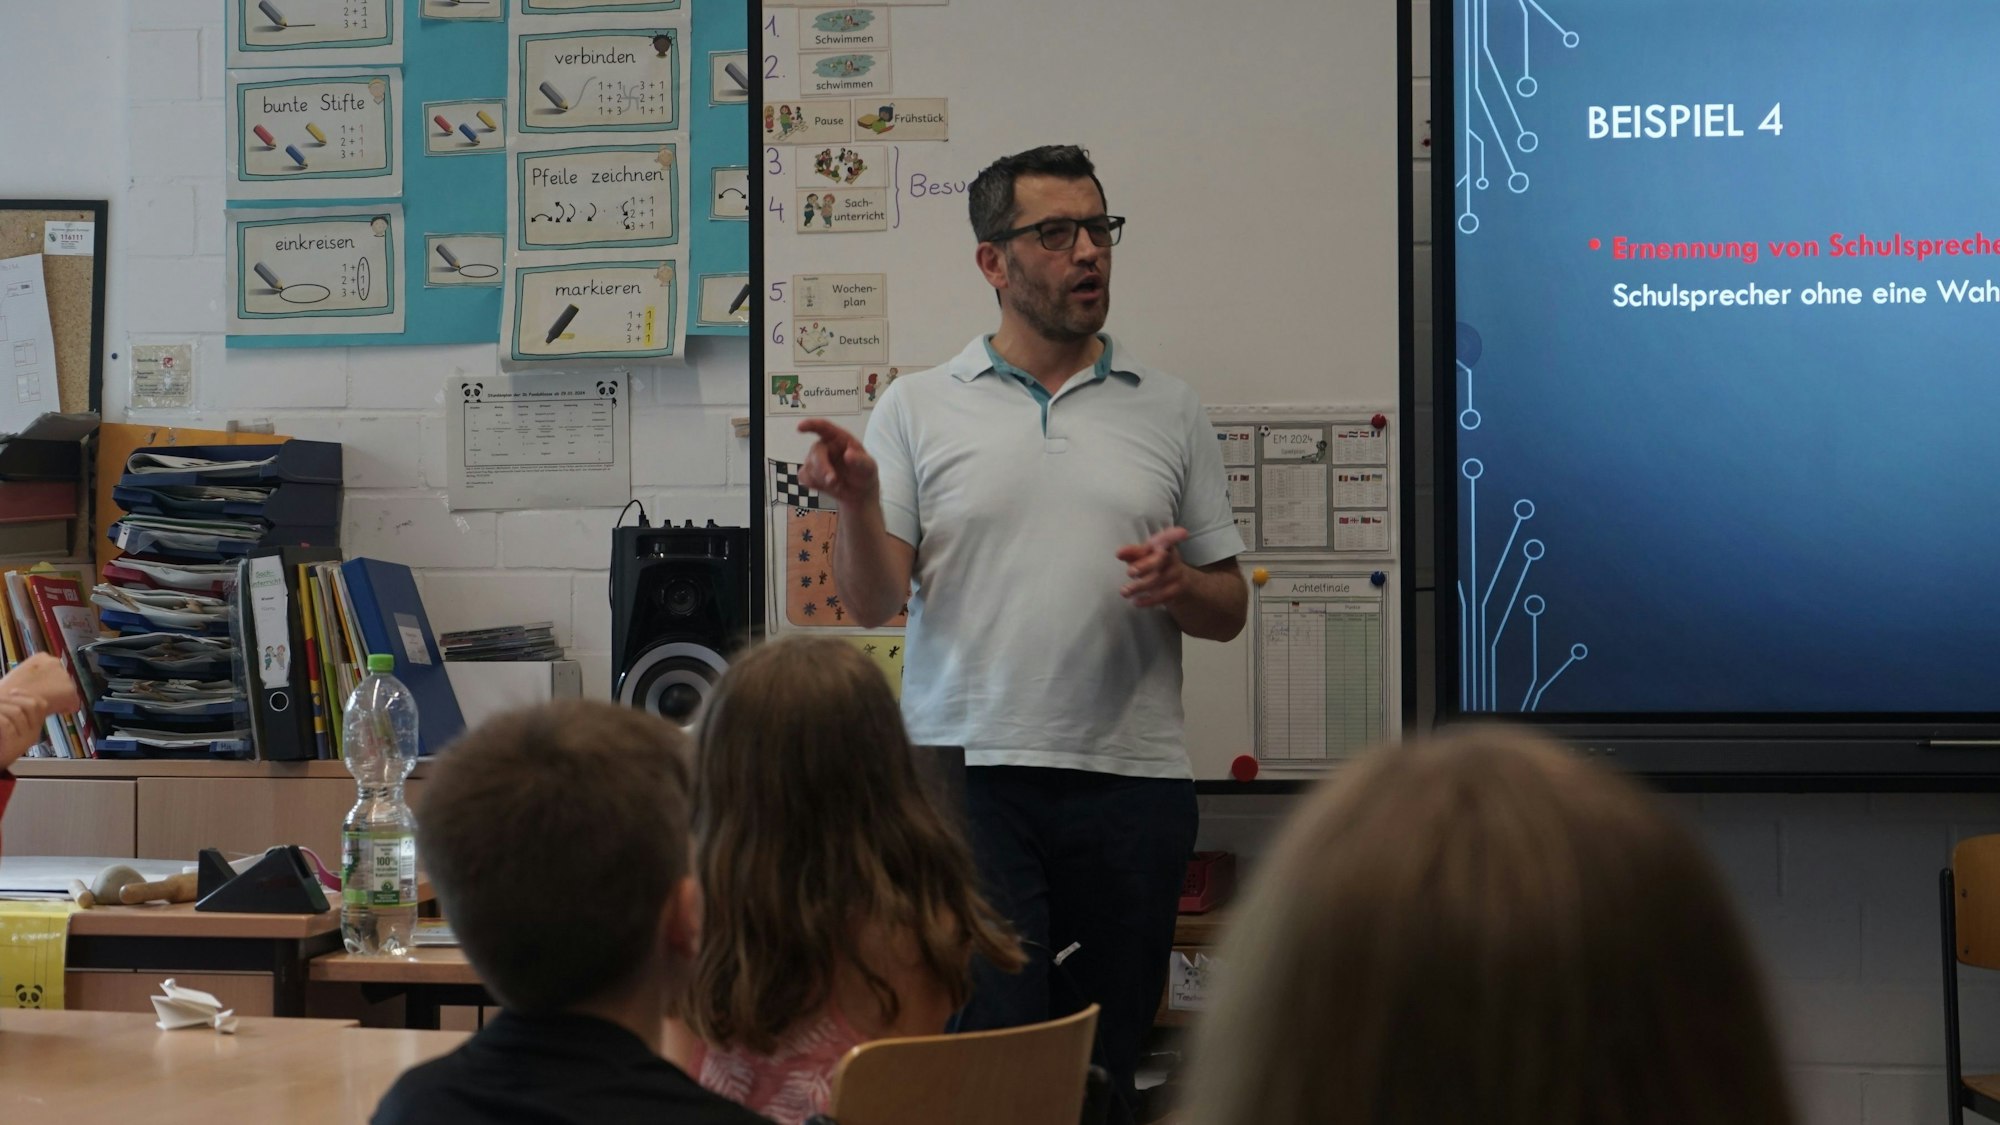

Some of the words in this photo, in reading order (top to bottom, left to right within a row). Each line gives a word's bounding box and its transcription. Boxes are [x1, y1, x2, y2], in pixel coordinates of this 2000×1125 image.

[344, 7, 349, 16] 2
[361, 6, 367, 16] 1
[344, 19, 350, 29] 3
[361, 19, 367, 28] 1
[765, 15, 779, 37] 1.
[816, 35, 873, 44] Schwimmen
[555, 46, 636, 64] verbinden
[763, 55, 785, 79] 2.
[599, 81, 602, 90] 1
[617, 81, 621, 90] 1
[640, 81, 644, 90] 3
[660, 81, 663, 90] 1
[816, 80, 873, 90] schwimmen
[264, 96, 307, 113] bunte
[320, 93, 364, 112] Stifte
[598, 94, 603, 103] 1
[617, 94, 623, 103] 2
[640, 93, 645, 103] 2
[659, 93, 663, 102] 1
[598, 107, 602, 115] 1
[617, 106, 623, 115] 3
[641, 106, 644, 115] 1
[659, 106, 663, 115] 1
[815, 117, 844, 125] Pause
[895, 112, 945, 123] Frühstück
[1588, 104, 1743, 138] BEISPIEL
[1758, 102, 1783, 136] 4
[767, 147, 785, 175] 3.
[533, 168, 577, 187] Pfeile
[592, 166, 665, 183] zeichnen
[649, 196, 654, 205] 1
[845, 198, 872, 208] Sach-
[650, 209, 654, 217] 1
[769, 196, 784, 223] 4.
[835, 211, 884, 221] unterricht
[649, 221, 654, 230] 1
[276, 234, 355, 251] einkreisen
[1613, 236, 1758, 263] Ernennung
[1768, 240, 1820, 256] von
[361, 263, 366, 271] 1
[361, 276, 366, 284] 1
[361, 288, 366, 296] 1
[556, 279, 641, 296] markieren
[770, 282, 787, 303] 5.
[832, 284, 877, 293] Wochen-
[1613, 282, 1791, 311] Schulsprecher
[1800, 282, 1862, 304] ohne
[1872, 282, 1926, 304] eine
[844, 297, 866, 308] plan
[840, 335, 879, 344] Deutsch
[1274, 435, 1287, 443] EM
[1291, 434, 1313, 443] 2024
[1292, 584, 1350, 593] Achtelfinale
